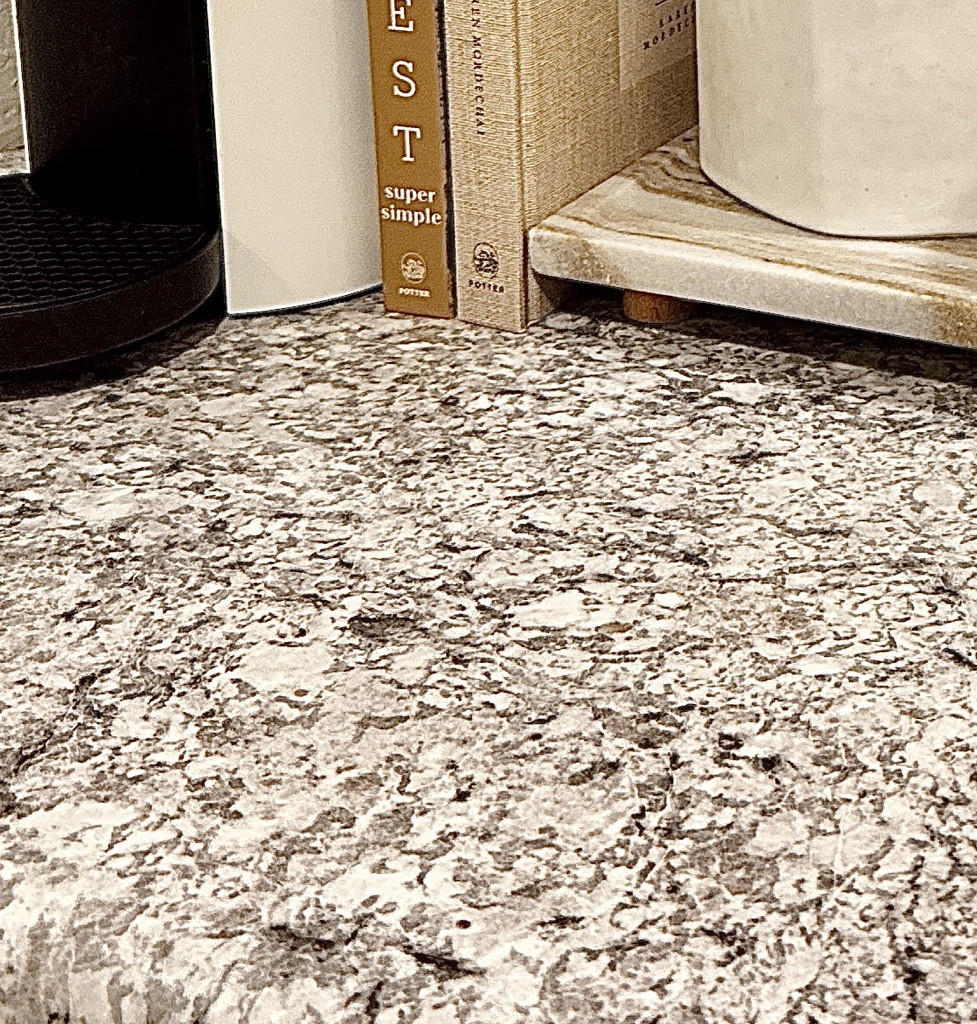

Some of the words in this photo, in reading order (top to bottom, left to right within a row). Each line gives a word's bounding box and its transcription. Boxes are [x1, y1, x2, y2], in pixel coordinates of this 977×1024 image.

[472, 35, 485, 136] MORDECHAI
[384, 185, 436, 204] super
[380, 204, 442, 227] simple
[399, 287, 430, 298] POTTER
[468, 279, 505, 294] POTTER
